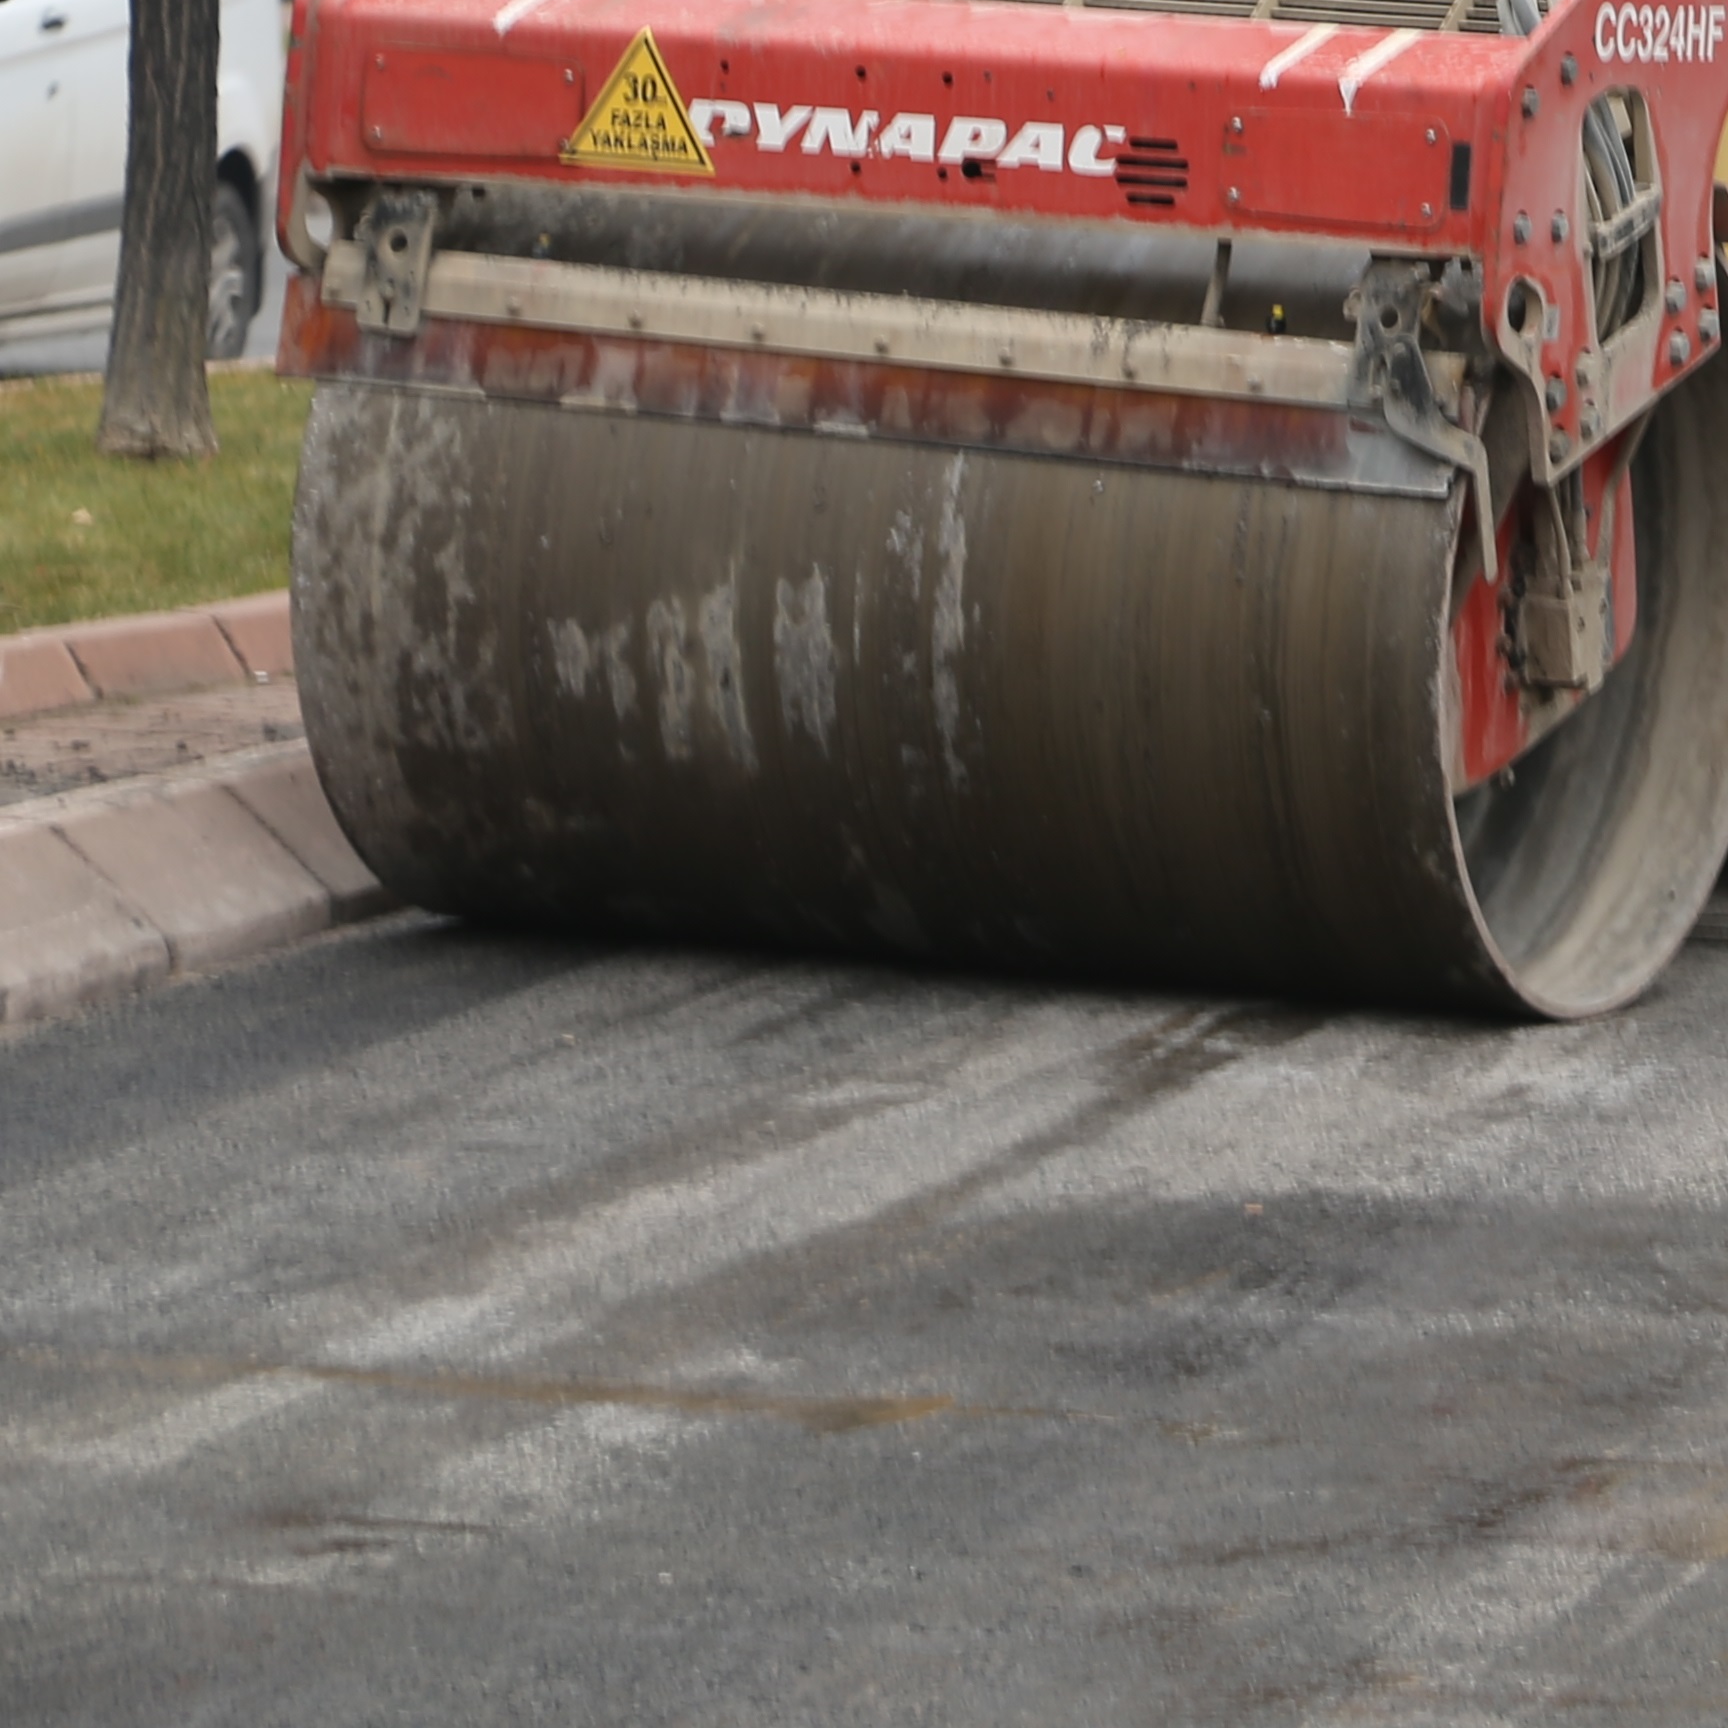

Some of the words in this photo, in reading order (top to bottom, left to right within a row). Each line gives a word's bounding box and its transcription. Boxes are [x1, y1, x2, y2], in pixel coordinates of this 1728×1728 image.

[1595, 1, 1726, 63] CC324HF
[611, 108, 666, 131] FAZLA
[589, 127, 688, 161] YAKLAŞMA
